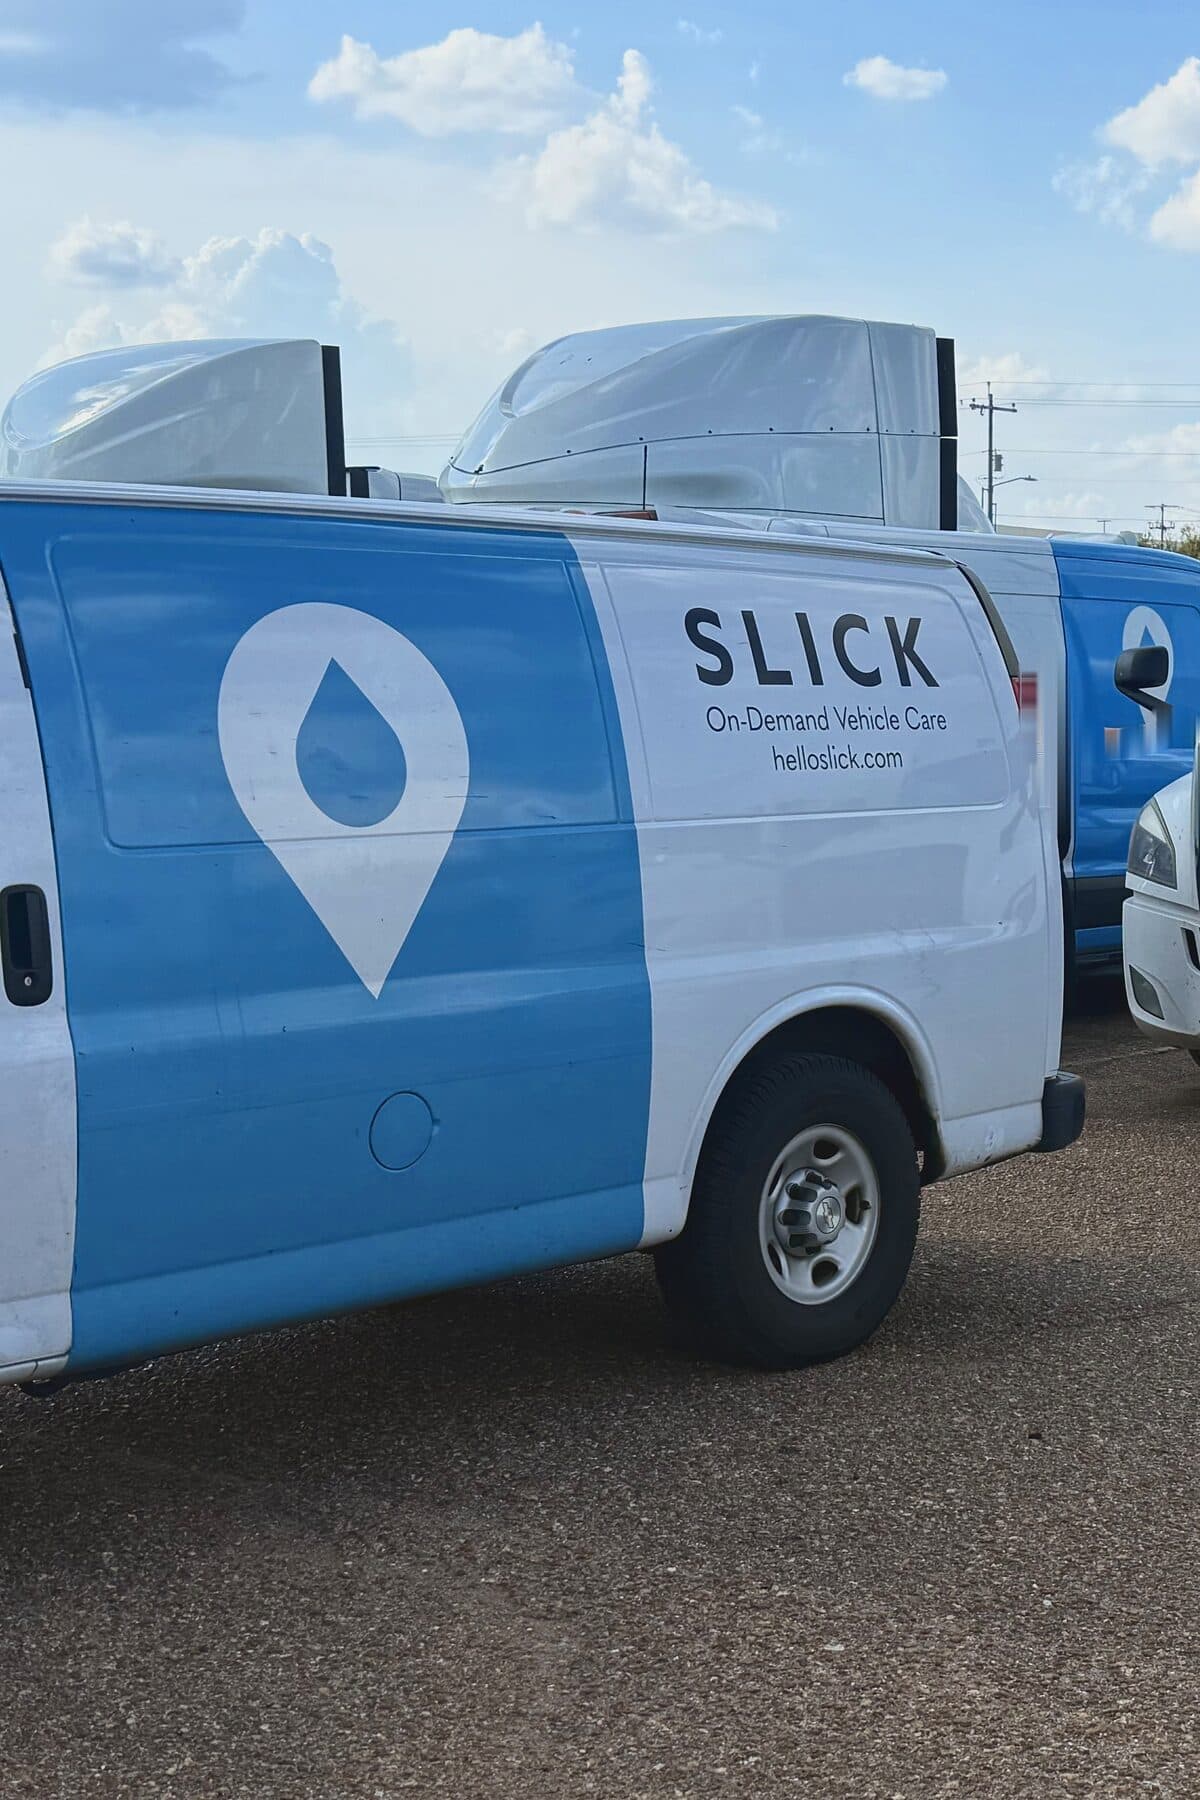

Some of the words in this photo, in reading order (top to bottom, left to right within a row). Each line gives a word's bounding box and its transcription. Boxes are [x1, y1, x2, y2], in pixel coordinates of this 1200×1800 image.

[684, 607, 940, 687] SLICK
[706, 705, 830, 732] On-Demand
[833, 705, 900, 731] Vehicle
[904, 706, 947, 731] Care
[772, 744, 904, 771] helloslick.com
